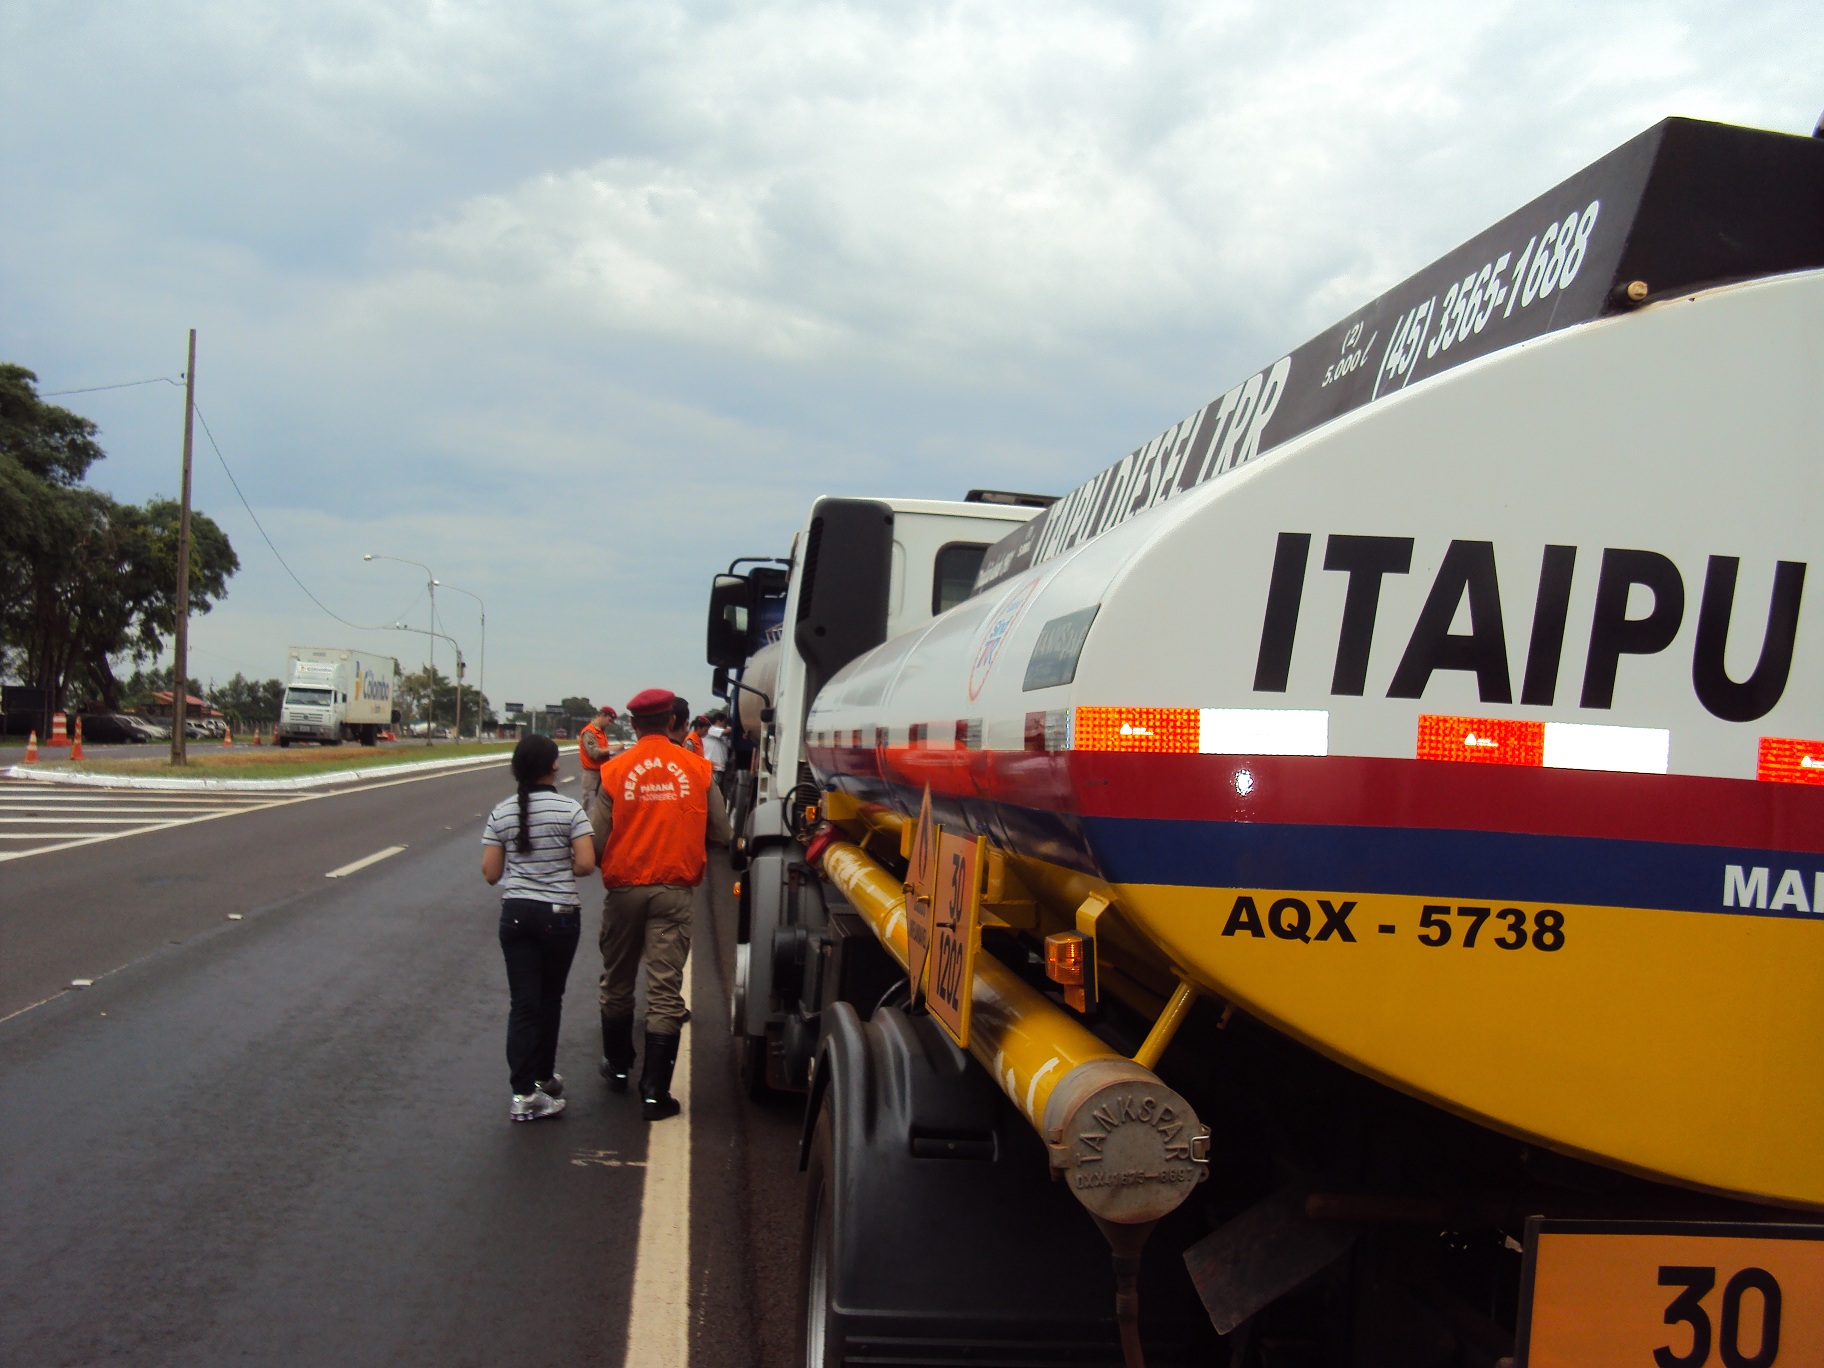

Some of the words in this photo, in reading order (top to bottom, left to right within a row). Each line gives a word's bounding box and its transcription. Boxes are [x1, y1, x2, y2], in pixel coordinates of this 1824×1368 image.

[1371, 296, 1437, 401] (45)
[1427, 199, 1600, 359] 3565-1688
[1341, 321, 1364, 354] (2)
[1029, 464, 1115, 569] ITAIPU
[1096, 403, 1211, 535] DIESEL
[1194, 356, 1292, 486] TRR
[1253, 532, 1807, 723] ITAIPU
[624, 757, 663, 801] DEFESA
[666, 762, 690, 798] CIVIL
[640, 781, 675, 793] PARANÁ
[949, 853, 967, 924] 30
[1221, 895, 1359, 945] AQX
[1417, 904, 1566, 952] 5738
[936, 930, 963, 1013] 1202
[1075, 1095, 1190, 1168] TANKSPAR
[1652, 1265, 1783, 1368] 30
